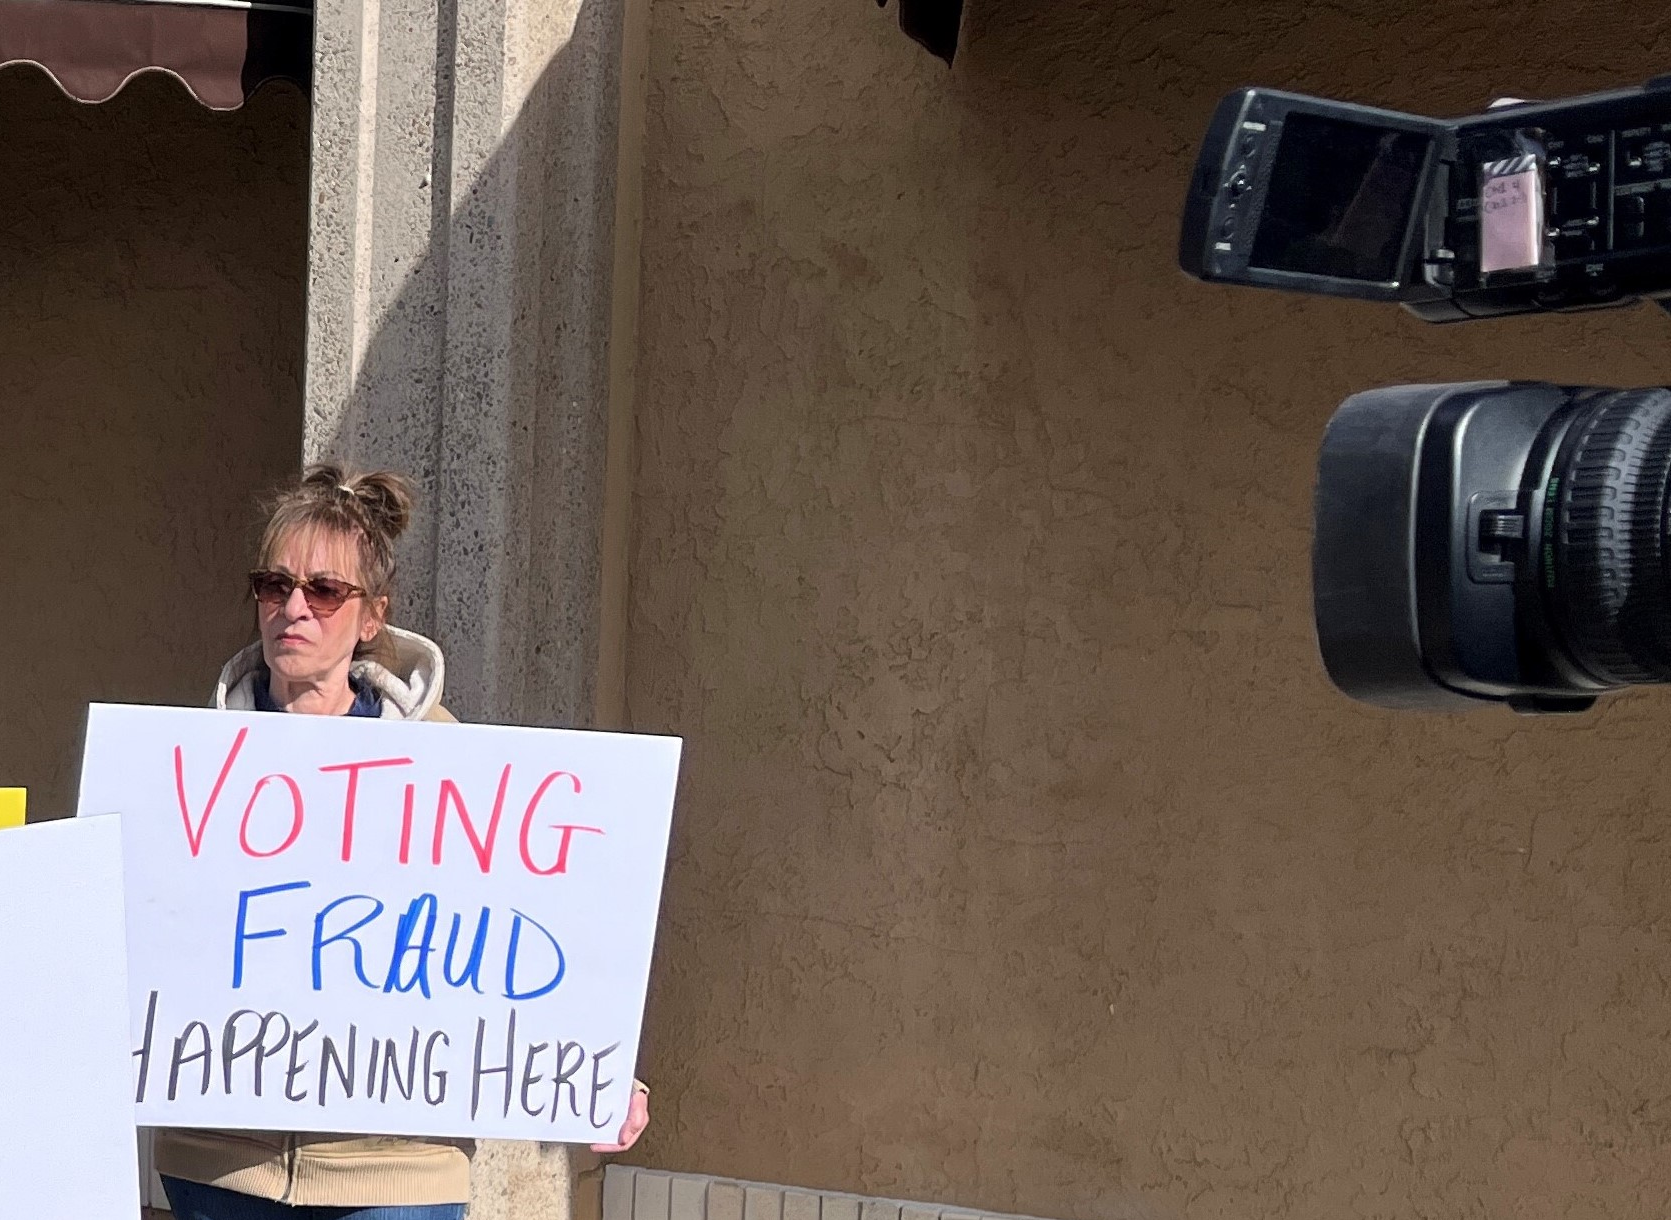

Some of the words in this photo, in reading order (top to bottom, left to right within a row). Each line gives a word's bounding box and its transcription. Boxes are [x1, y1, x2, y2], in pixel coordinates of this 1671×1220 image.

[174, 727, 605, 876] VOTING
[232, 880, 566, 1000] FRAUD
[471, 1007, 620, 1128] HERE
